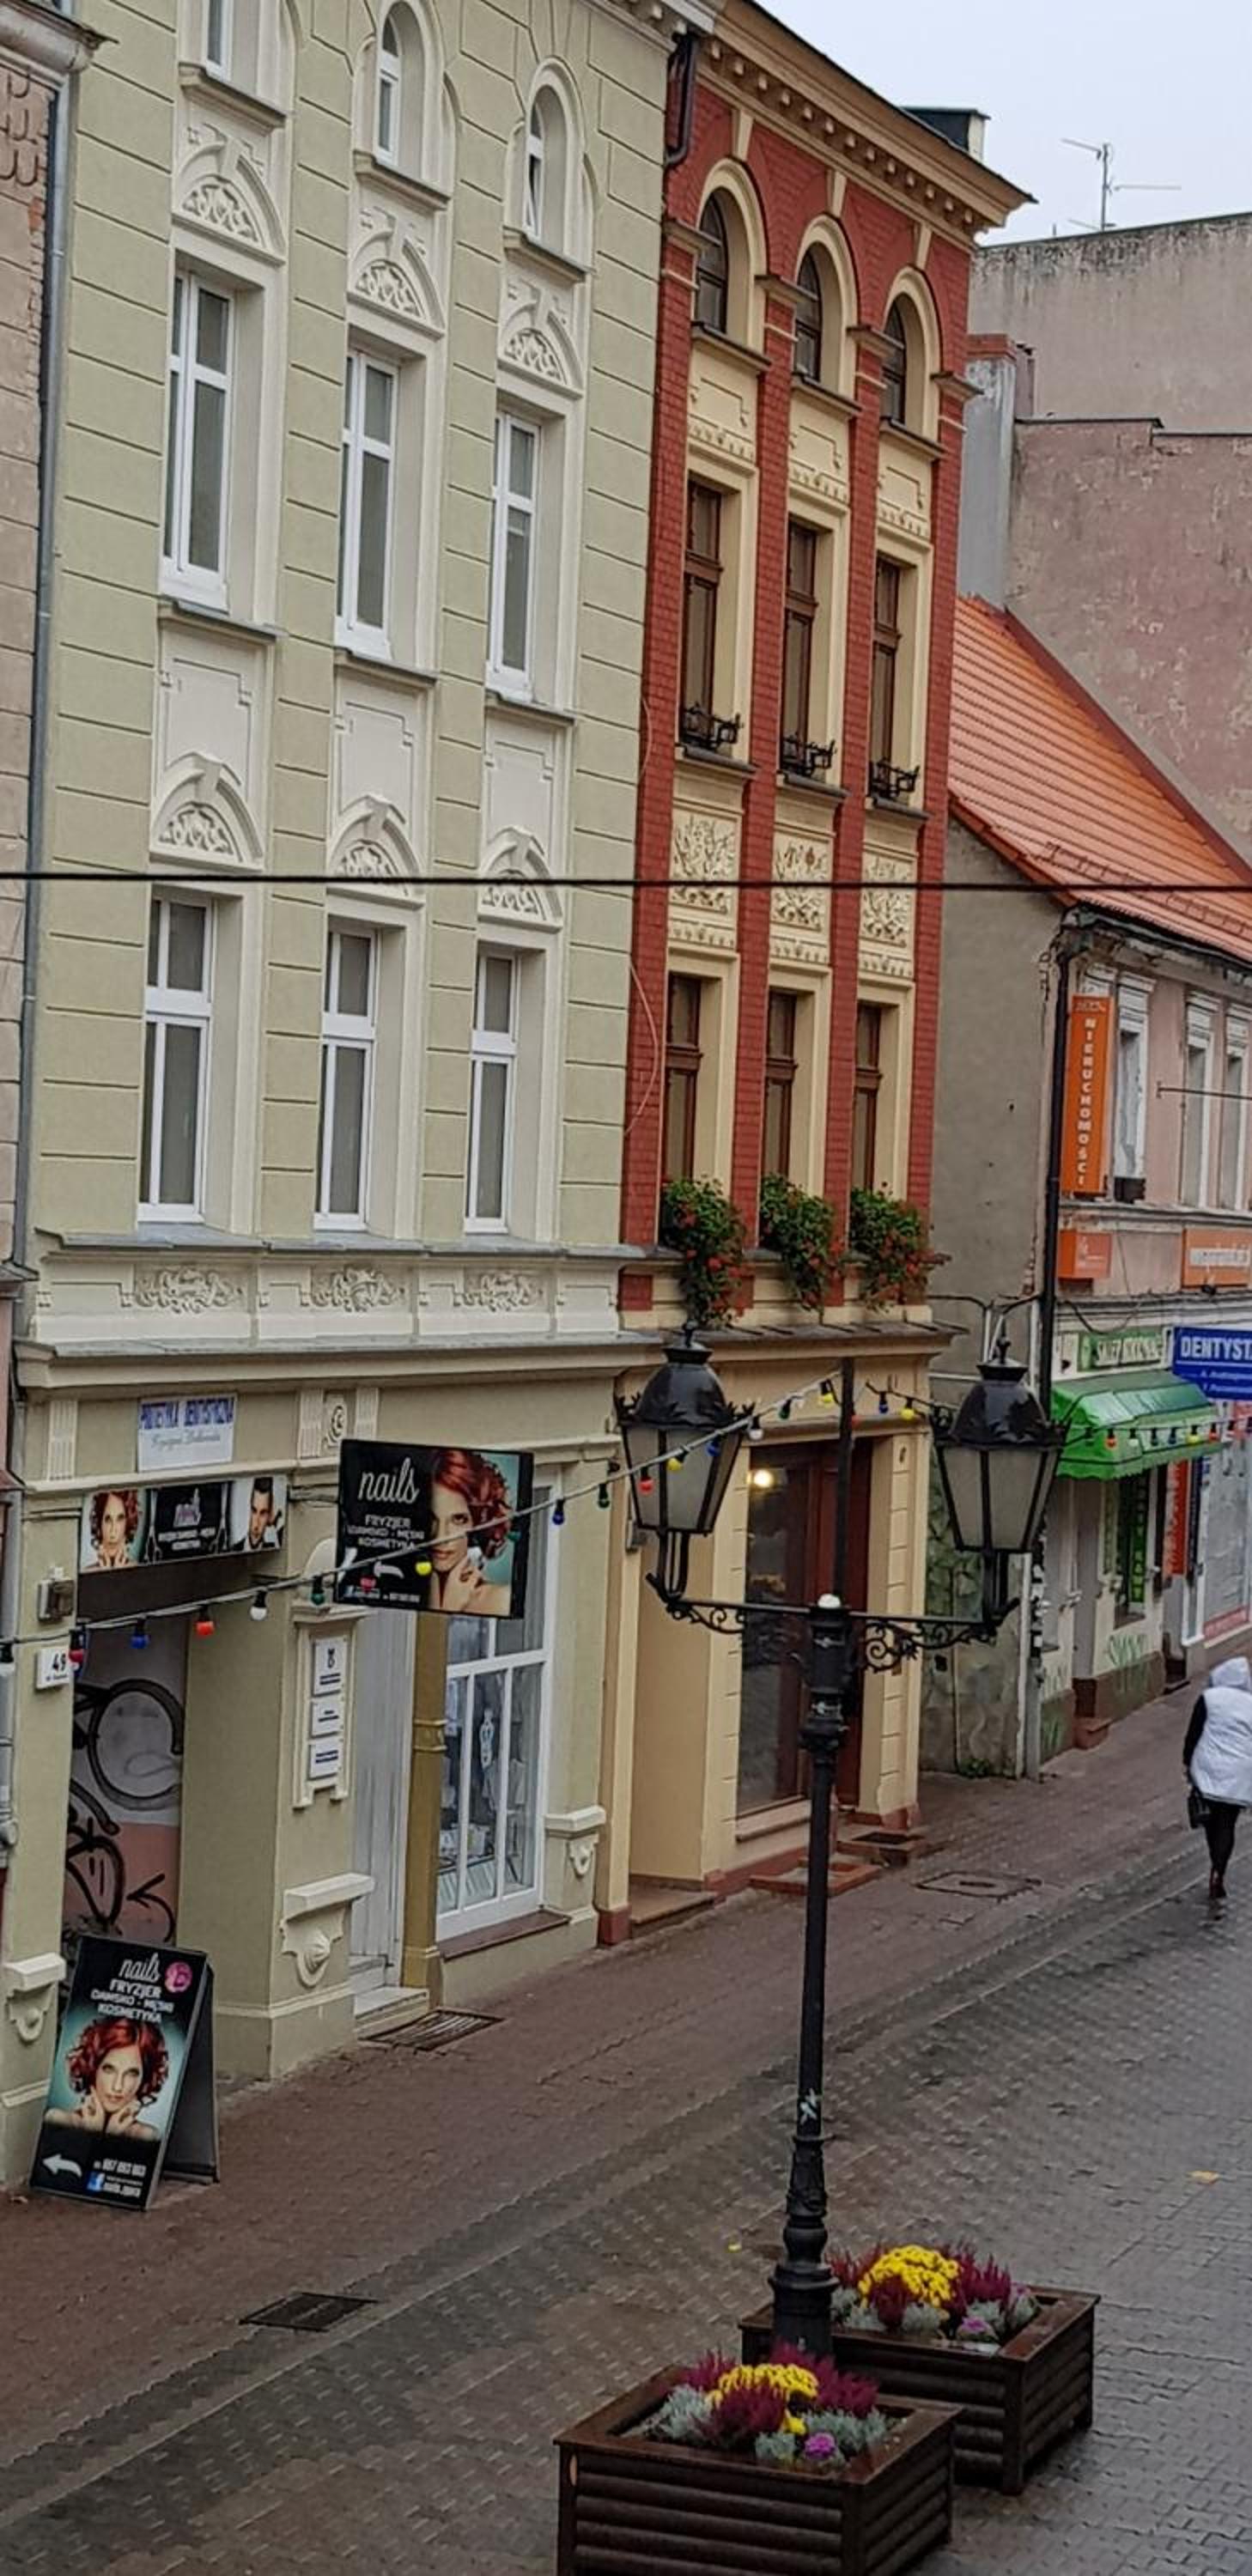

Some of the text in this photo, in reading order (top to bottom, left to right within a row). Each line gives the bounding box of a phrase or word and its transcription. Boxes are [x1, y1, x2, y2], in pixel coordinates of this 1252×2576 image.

[1181, 1336, 1252, 1360] DENTYST
[357, 1457, 420, 1504] nails
[52, 1653, 66, 1673] 49
[119, 1952, 161, 1983] nails
[109, 1978, 161, 2000] FRYZJER
